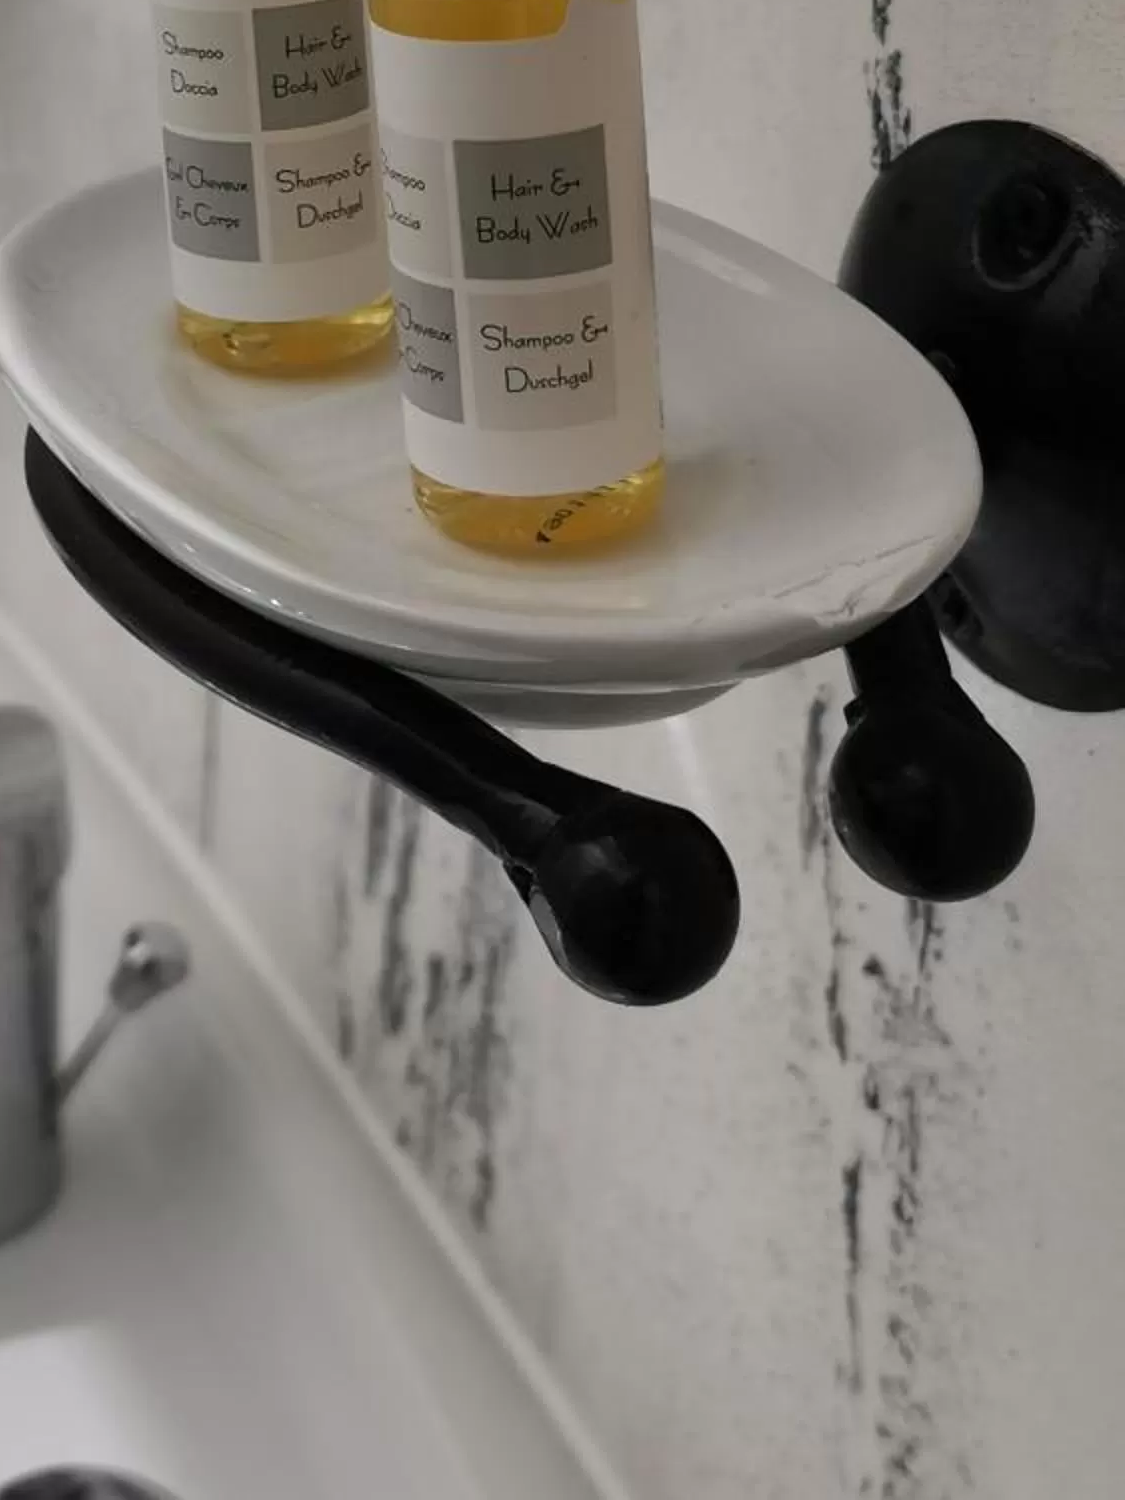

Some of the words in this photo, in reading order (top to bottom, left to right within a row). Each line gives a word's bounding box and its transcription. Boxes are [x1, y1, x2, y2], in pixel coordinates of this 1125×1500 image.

[285, 34, 328, 58] Hair
[272, 71, 318, 99] Body
[321, 55, 362, 88] Wash
[276, 168, 350, 193] Shampoo
[491, 173, 543, 202] Hair
[476, 215, 531, 244] Body
[535, 203, 599, 240] Wash
[479, 323, 575, 352] Shampoo
[504, 358, 594, 394] Duschgel
